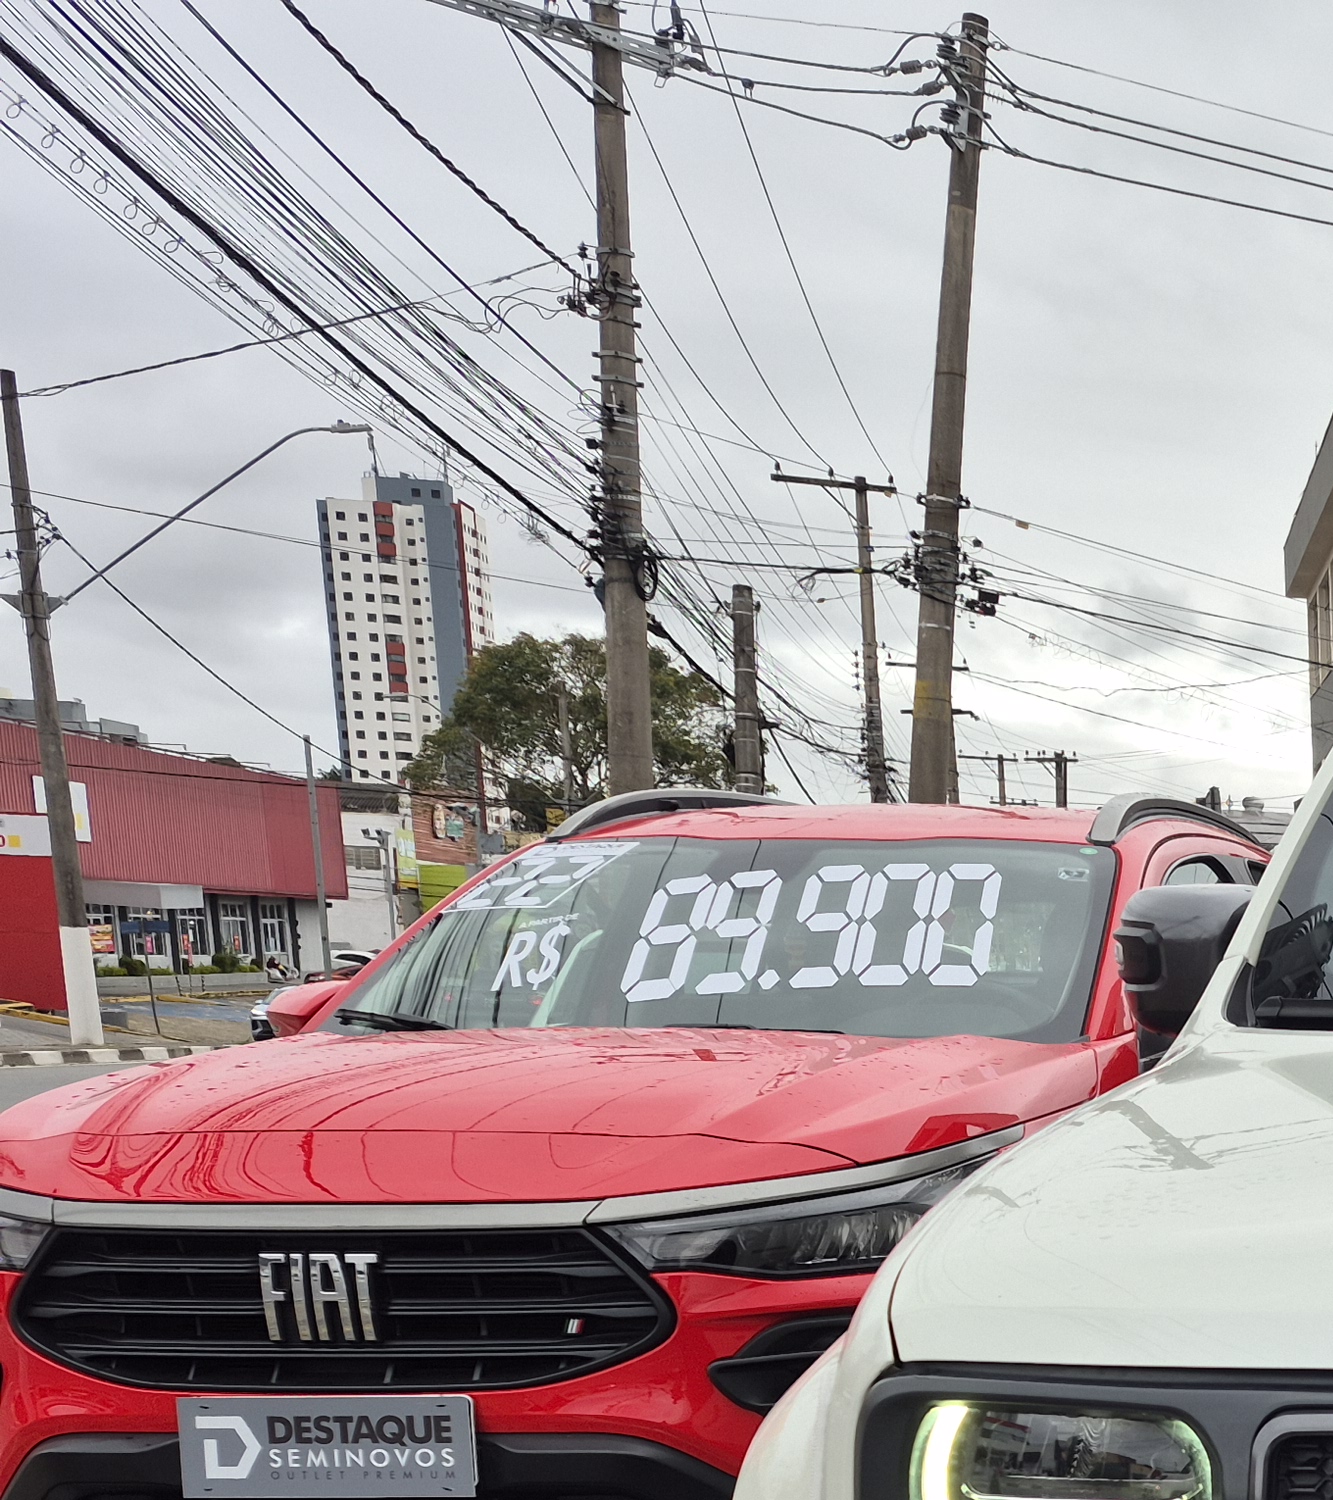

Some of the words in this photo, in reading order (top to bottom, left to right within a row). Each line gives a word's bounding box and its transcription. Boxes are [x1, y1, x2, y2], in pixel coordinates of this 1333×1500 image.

[258, 1252, 378, 1341] FIAT
[266, 1415, 453, 1447] DESTAQUE
[269, 1448, 456, 1468] SEMINOVOS
[270, 1470, 345, 1480] OUTLET
[363, 1470, 456, 1480] PREMIUM
